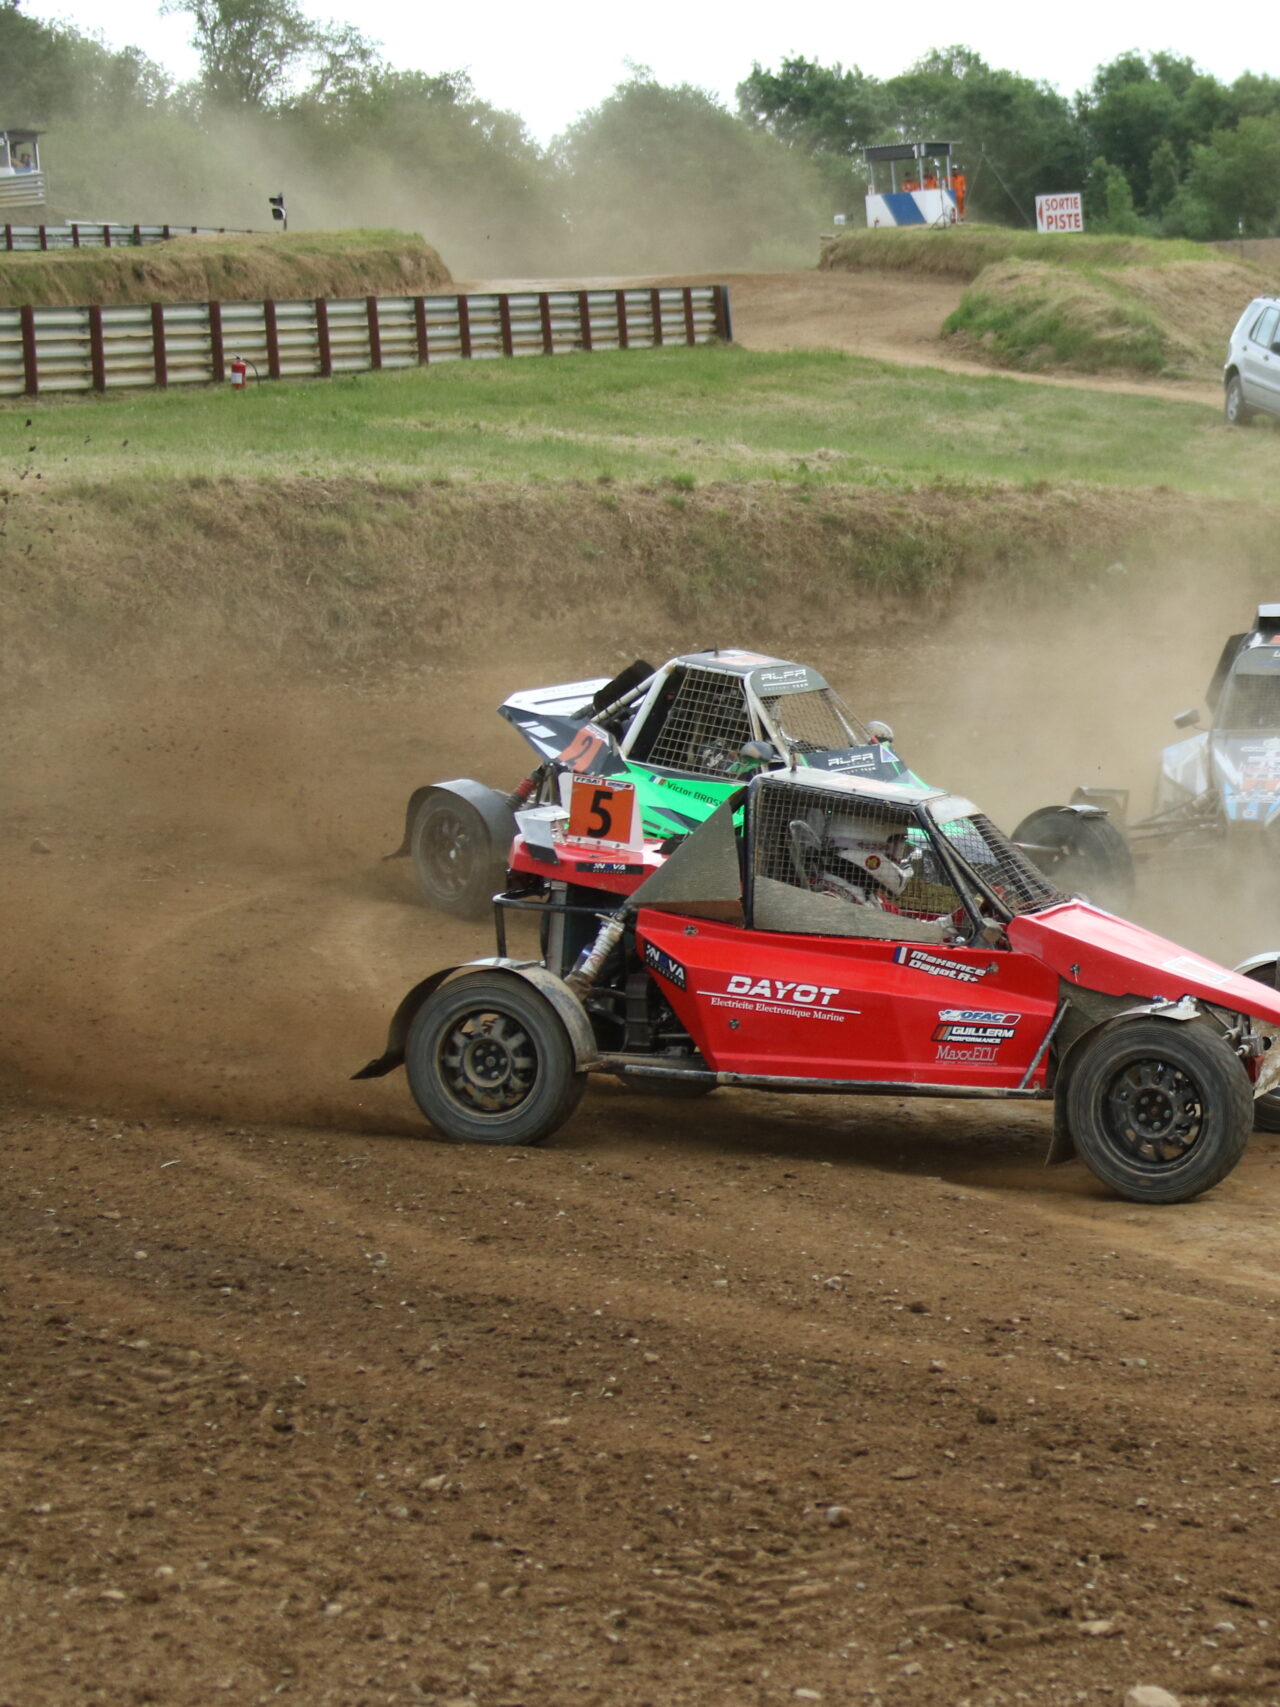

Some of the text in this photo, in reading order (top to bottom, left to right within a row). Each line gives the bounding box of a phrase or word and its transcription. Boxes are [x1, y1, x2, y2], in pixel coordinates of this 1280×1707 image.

[1045, 196, 1079, 212] SORTIE
[1046, 213, 1081, 230] PISTE
[568, 735, 593, 767] 2
[667, 781, 693, 796] Victor
[587, 790, 613, 838] 5
[910, 950, 986, 977] Maxence
[726, 975, 840, 1005] DAYOT
[711, 997, 845, 1022] Electricite Electronique Marine
[960, 1011, 1004, 1021] OFAC
[948, 1036, 1002, 1044] PERFORMANCE
[952, 1026, 1015, 1038] GUILLERM
